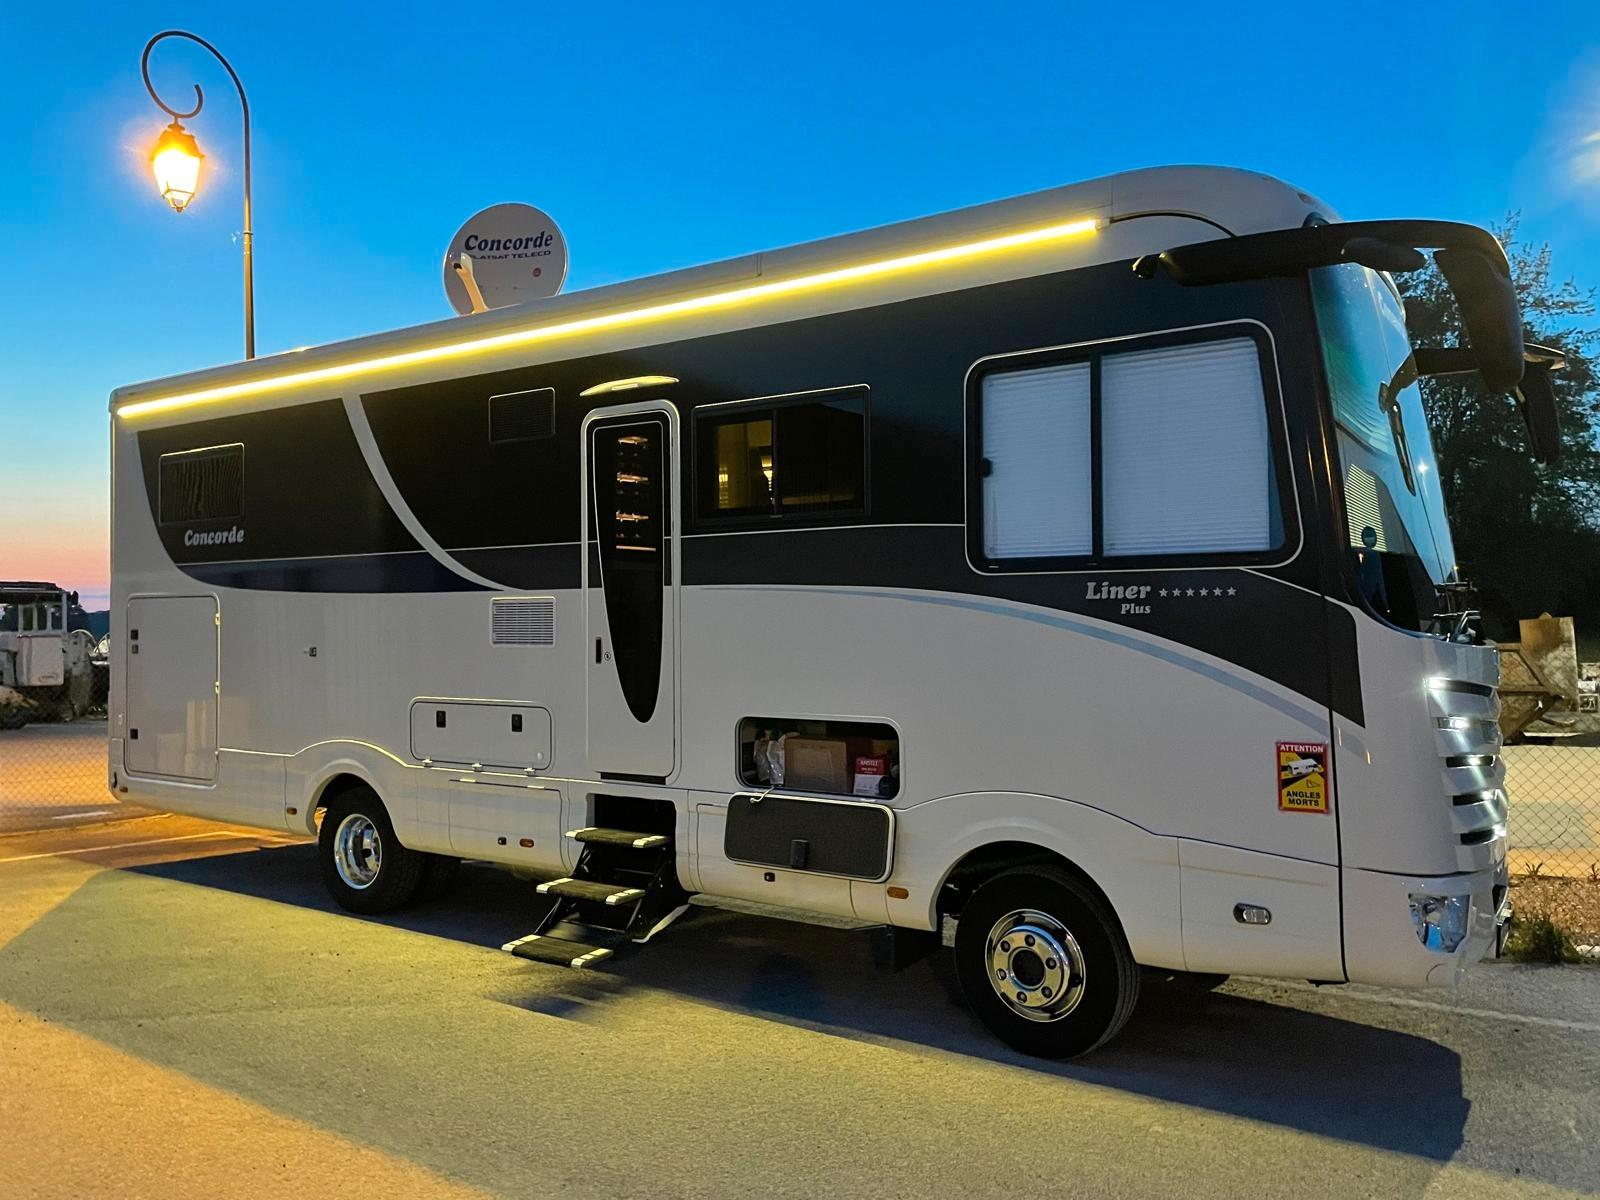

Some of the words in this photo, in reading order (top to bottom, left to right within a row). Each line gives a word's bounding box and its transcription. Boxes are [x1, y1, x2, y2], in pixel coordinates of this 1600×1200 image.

[464, 230, 553, 252] Concorde
[512, 250, 551, 259] TELECO
[184, 525, 245, 546] Concorde
[1085, 581, 1151, 600] Liner
[1120, 603, 1151, 614] Plus
[1280, 744, 1324, 753] ATTENTION
[1286, 791, 1321, 799] ANGLES
[1288, 798, 1320, 806] MORTS
